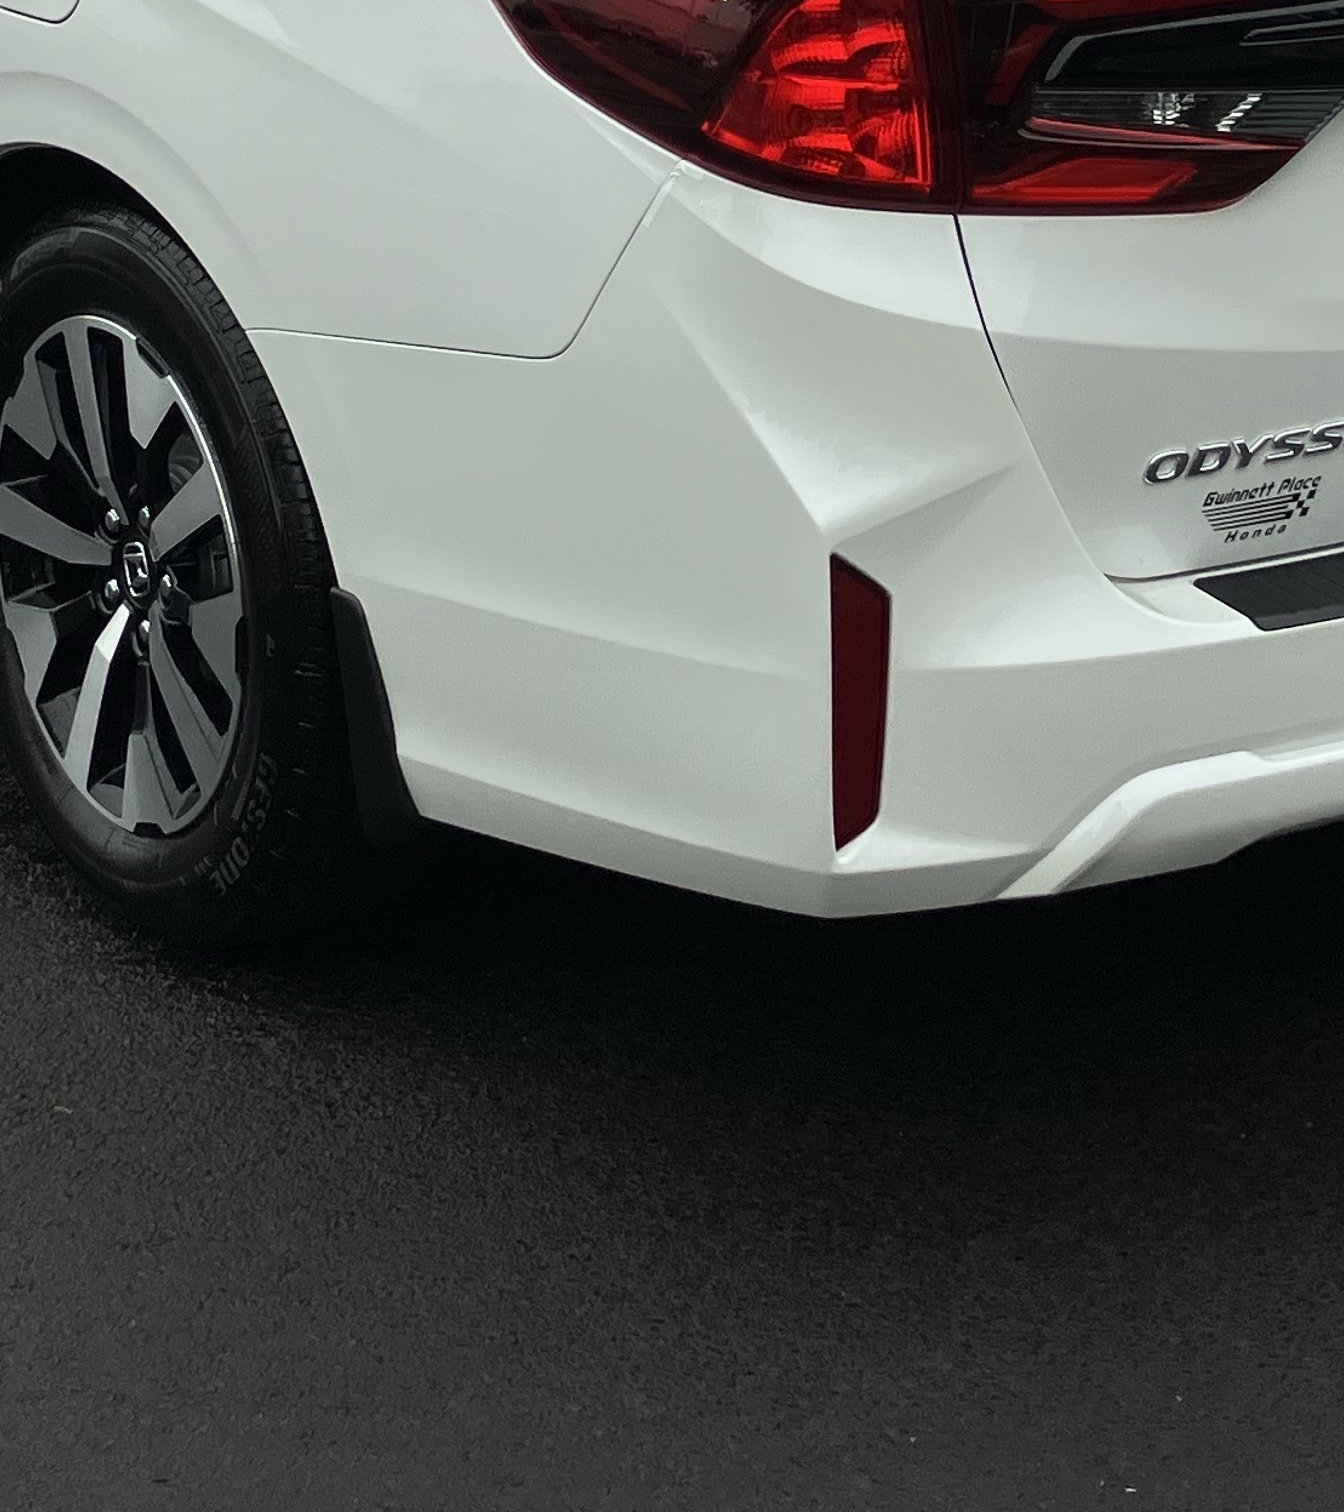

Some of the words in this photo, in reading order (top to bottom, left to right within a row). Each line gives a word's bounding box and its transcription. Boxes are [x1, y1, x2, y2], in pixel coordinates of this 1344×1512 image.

[1202, 481, 1275, 508] Gwinnett
[1277, 475, 1323, 495] Place
[1223, 524, 1288, 544] Honda
